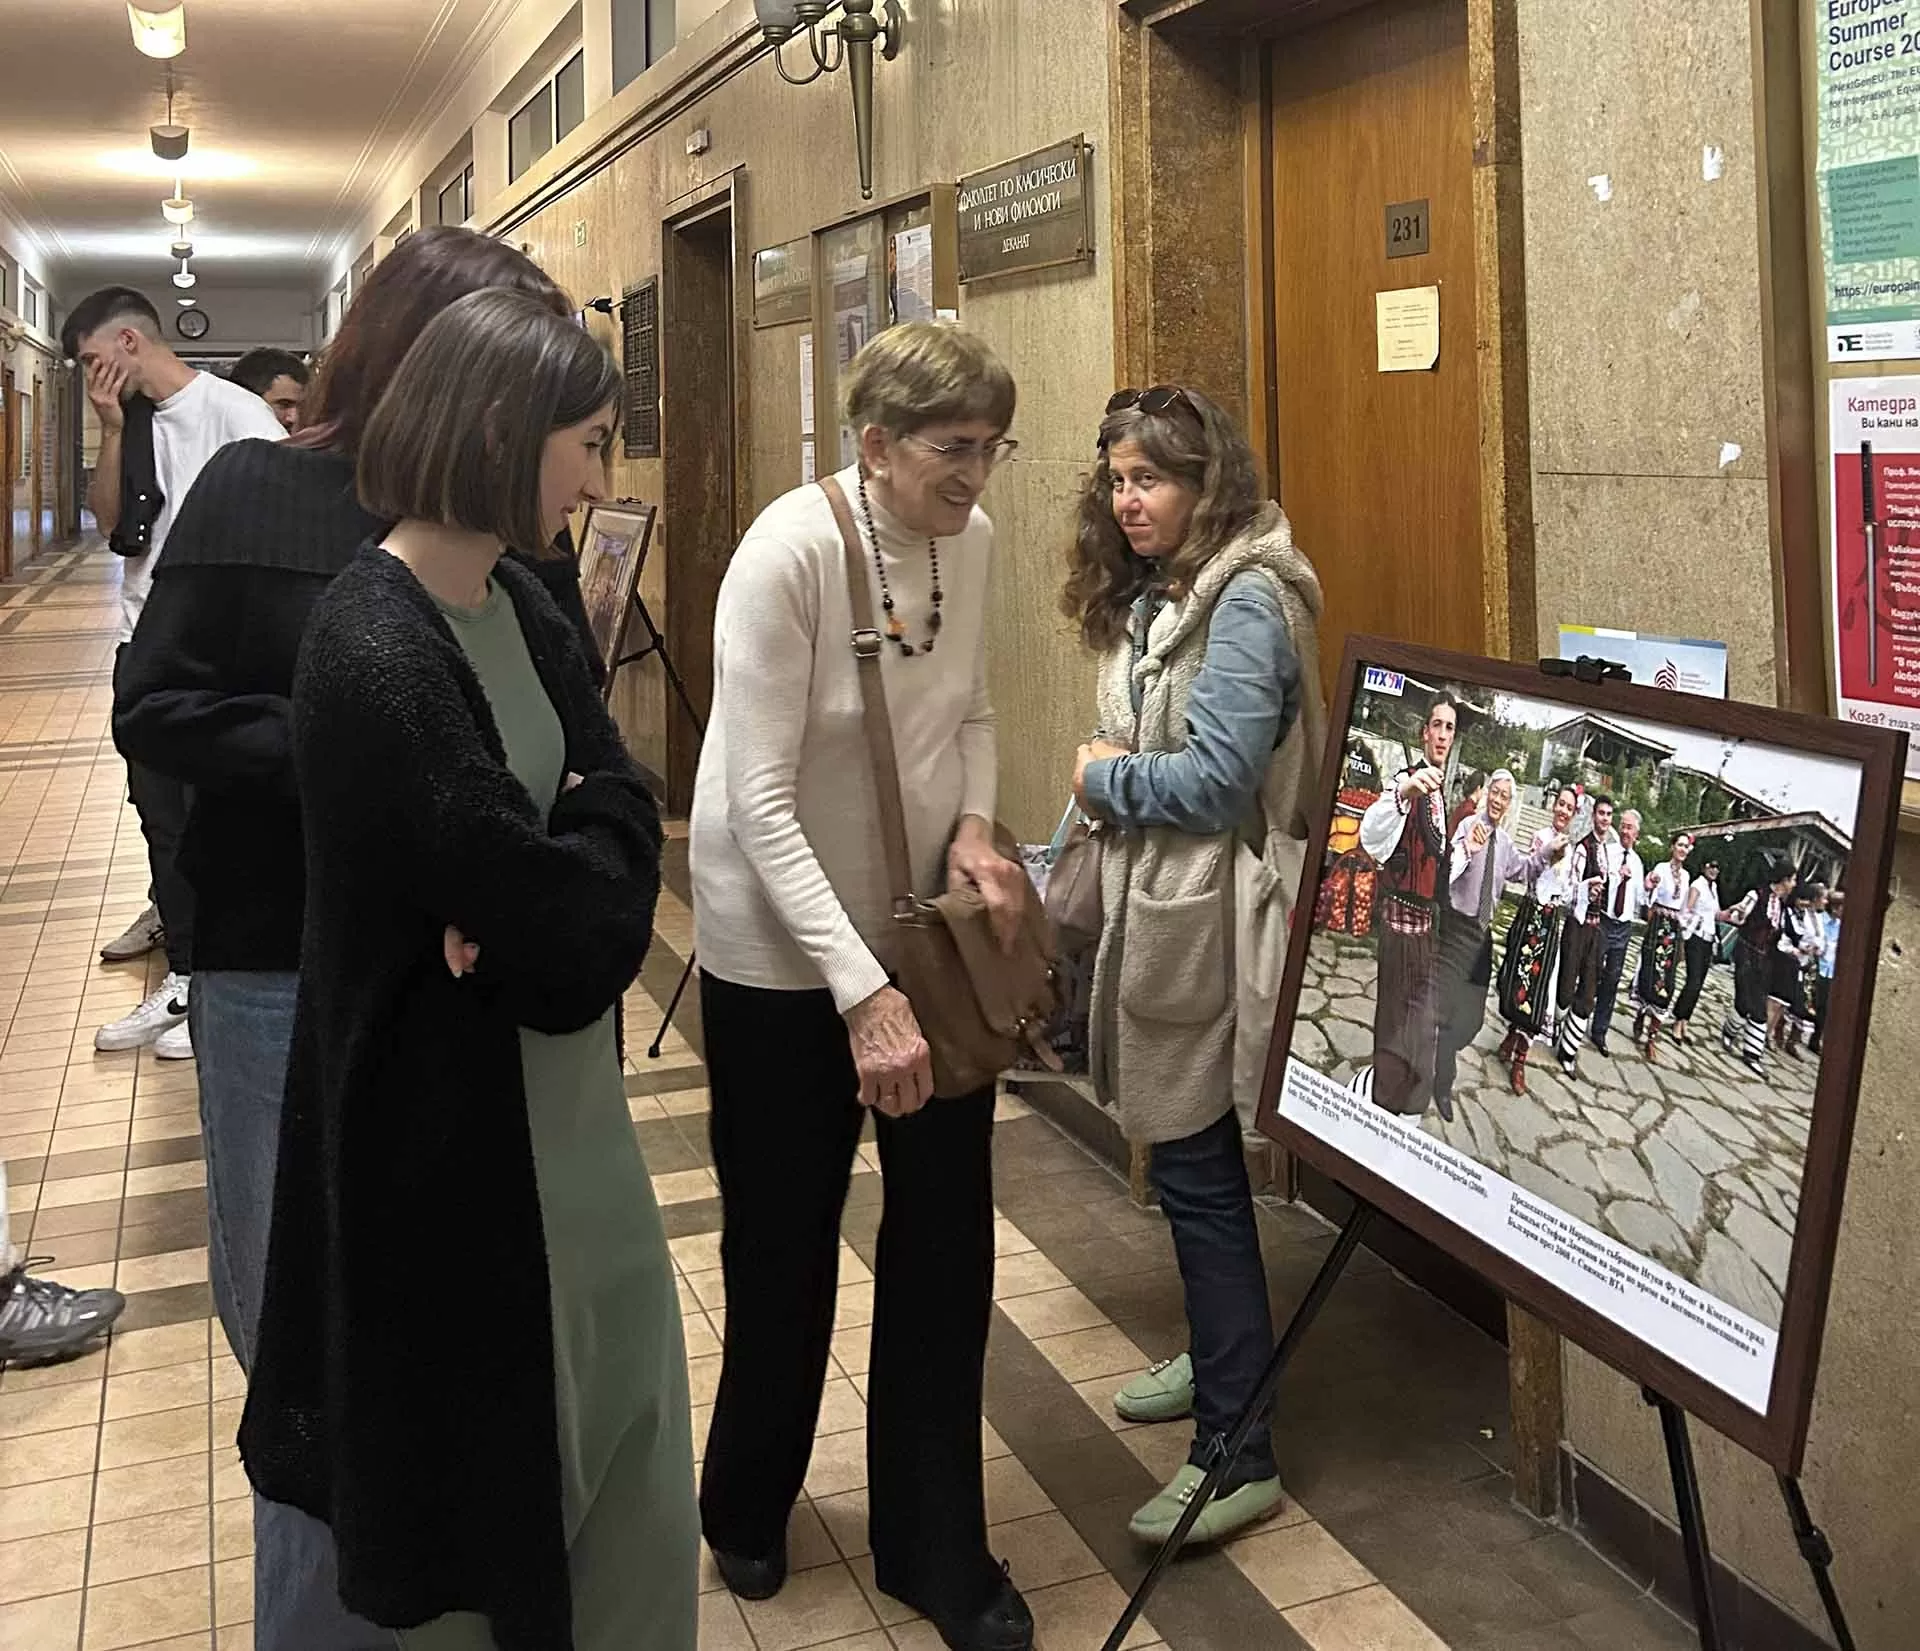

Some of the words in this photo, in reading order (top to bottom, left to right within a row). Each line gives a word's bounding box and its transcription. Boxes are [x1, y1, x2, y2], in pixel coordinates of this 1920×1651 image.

[1829, 0, 1901, 20] Europ
[1829, 12, 1908, 45] Summer
[1829, 43, 1895, 71] Course
[1900, 30, 1920, 55] 20
[1000, 178, 1014, 198] ПО
[974, 213, 981, 232] И
[984, 205, 1009, 229] НОВИ
[1392, 214, 1422, 243] 231
[1002, 233, 1031, 253] ДЕКАНАТ
[1847, 397, 1917, 415] Катедра
[1862, 417, 1875, 428] Ви
[1877, 417, 1903, 428] кани
[1905, 418, 1919, 428] на
[1848, 708, 1886, 726] Кога?
